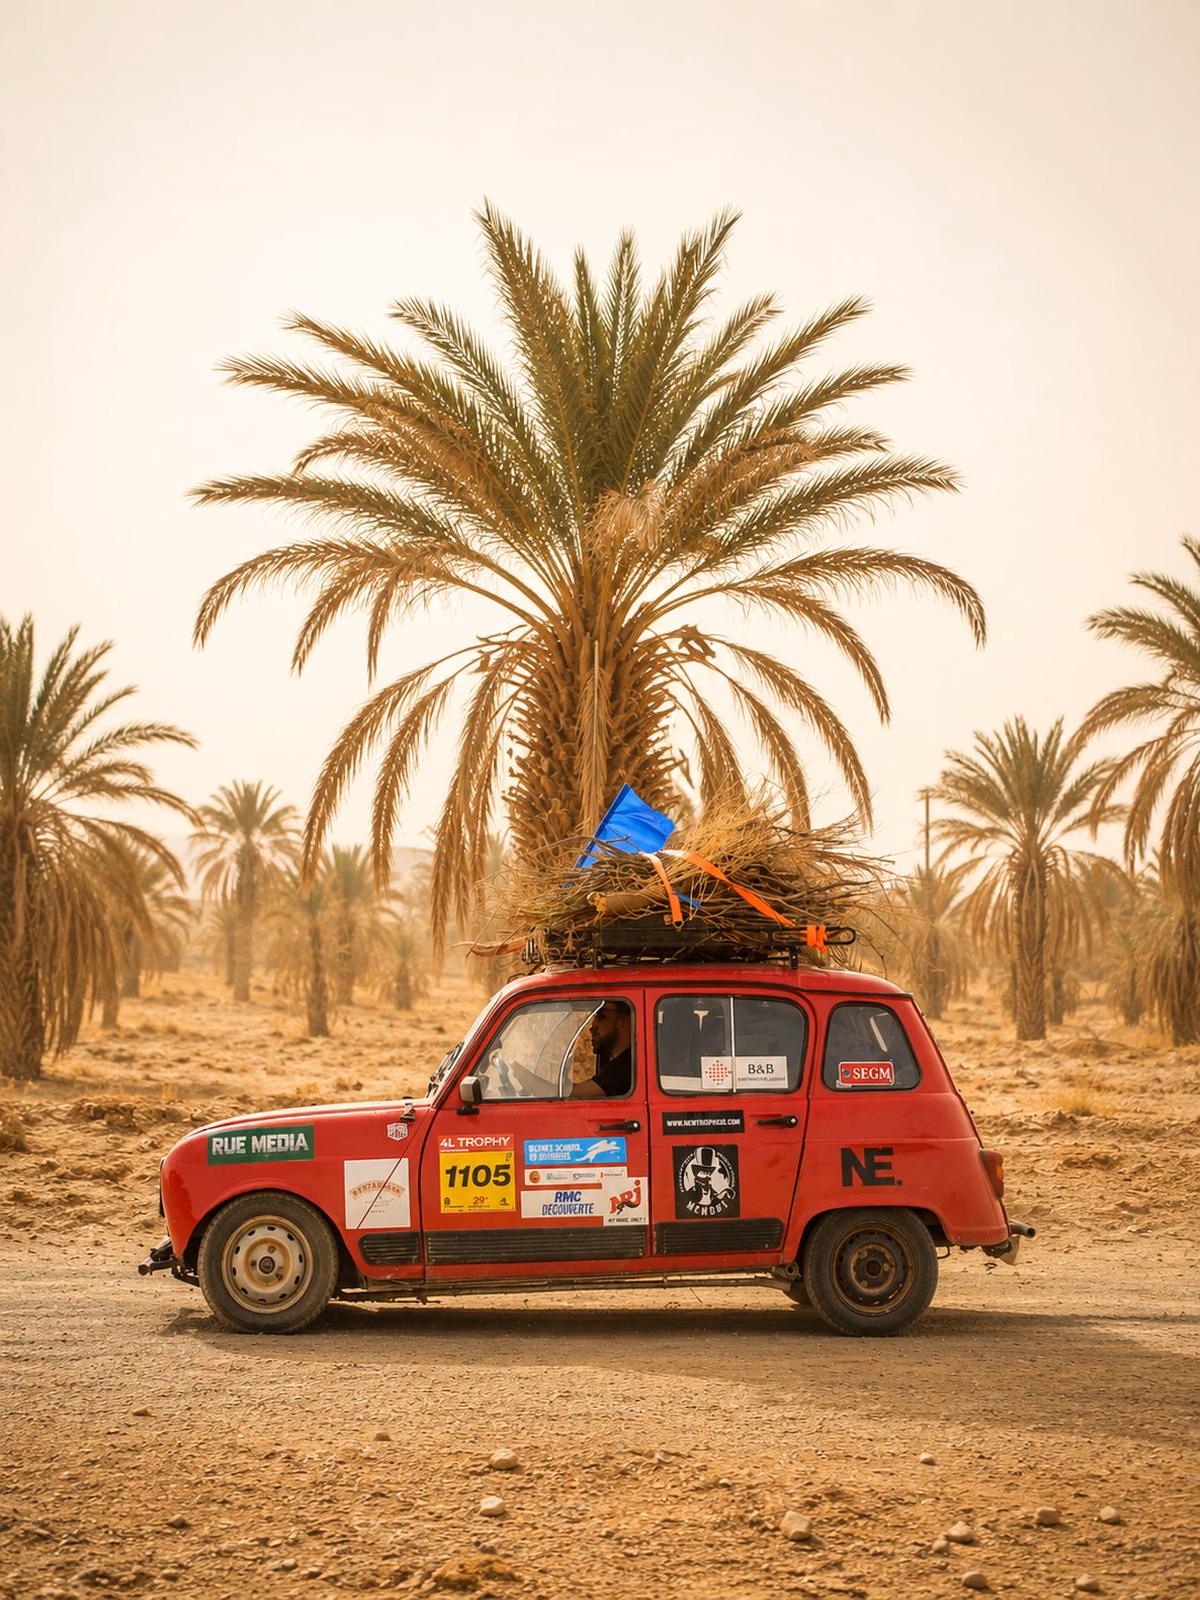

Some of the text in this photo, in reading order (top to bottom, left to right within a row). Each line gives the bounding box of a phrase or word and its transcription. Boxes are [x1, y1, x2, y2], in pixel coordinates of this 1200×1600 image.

[748, 1063, 775, 1075] B&B
[853, 1067, 891, 1080] SEGM
[212, 1132, 309, 1155] RUE MEDIA
[440, 1136, 511, 1148] 4L TROPHY
[445, 1164, 511, 1188] 1105
[554, 1191, 582, 1203] RMC
